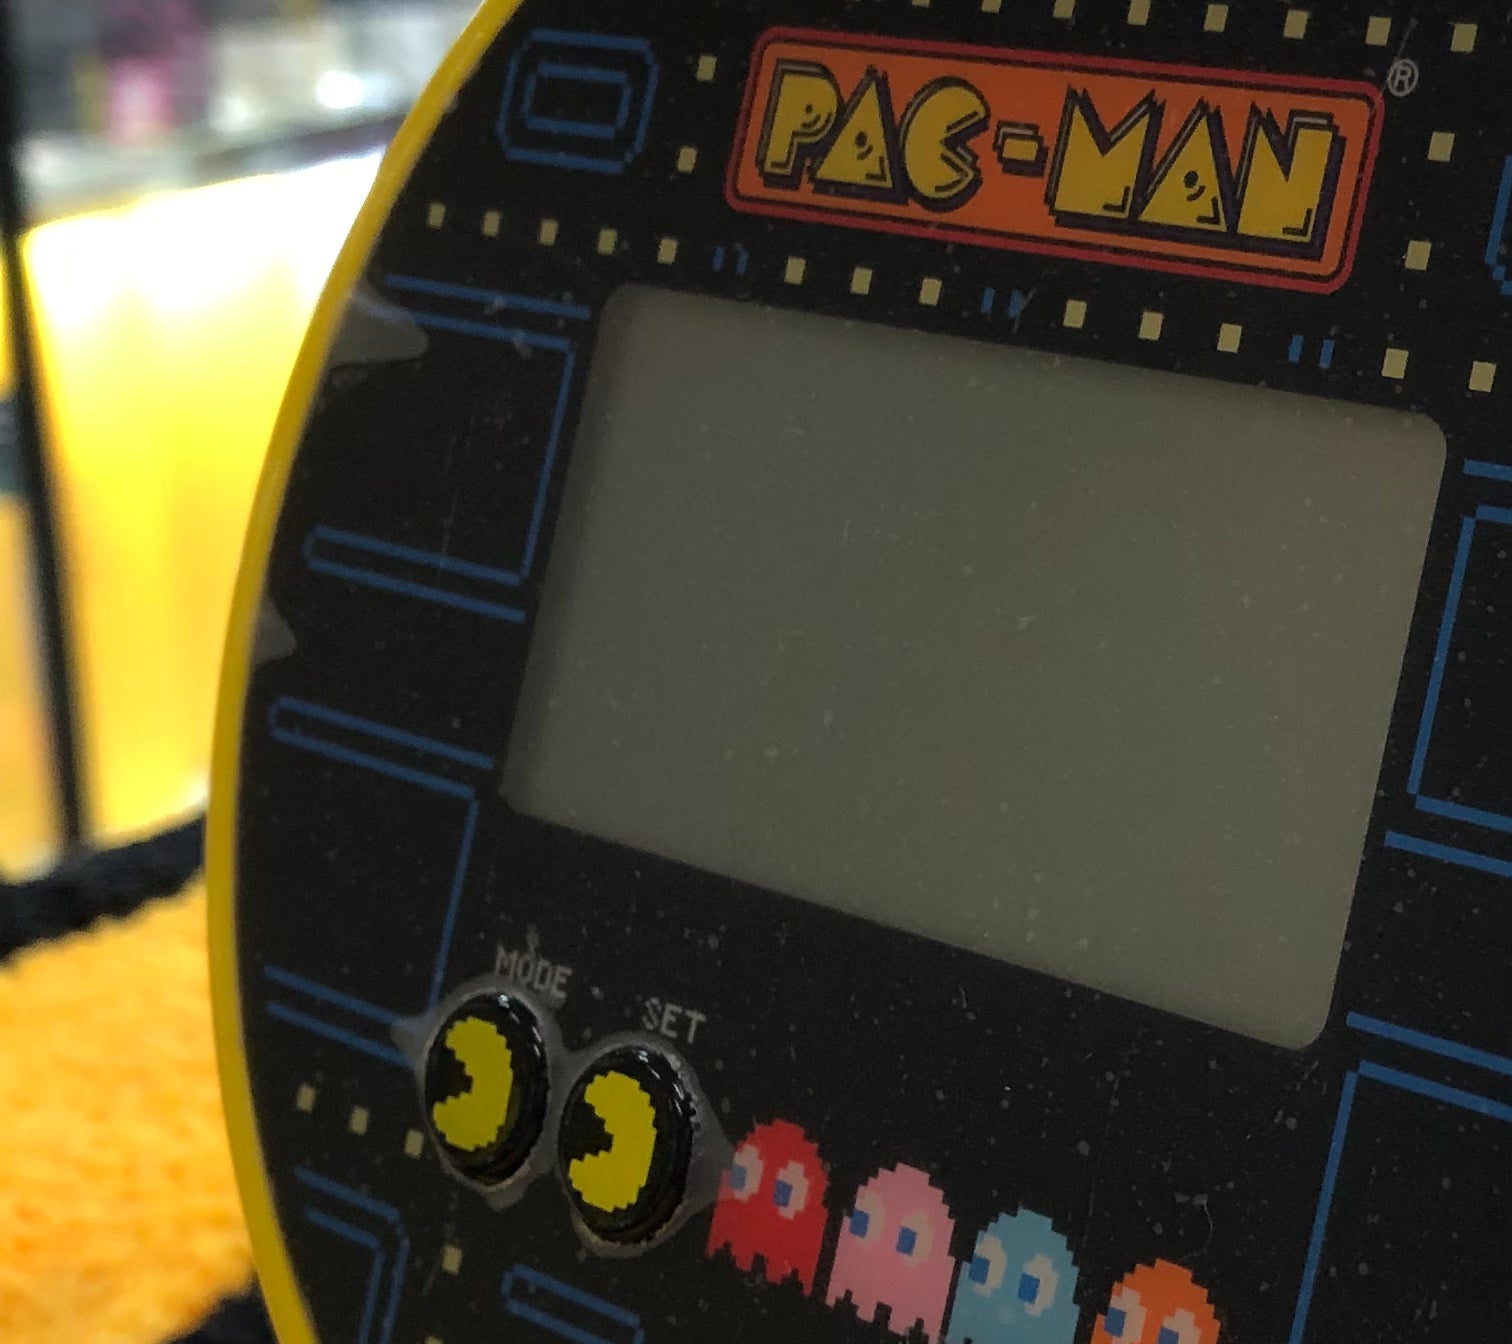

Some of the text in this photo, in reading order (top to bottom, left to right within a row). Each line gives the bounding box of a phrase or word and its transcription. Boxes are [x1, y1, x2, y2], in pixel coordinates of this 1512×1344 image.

[756, 59, 1346, 262] PAC-MAN
[494, 945, 573, 1002] MODE
[641, 997, 707, 1044] SET
